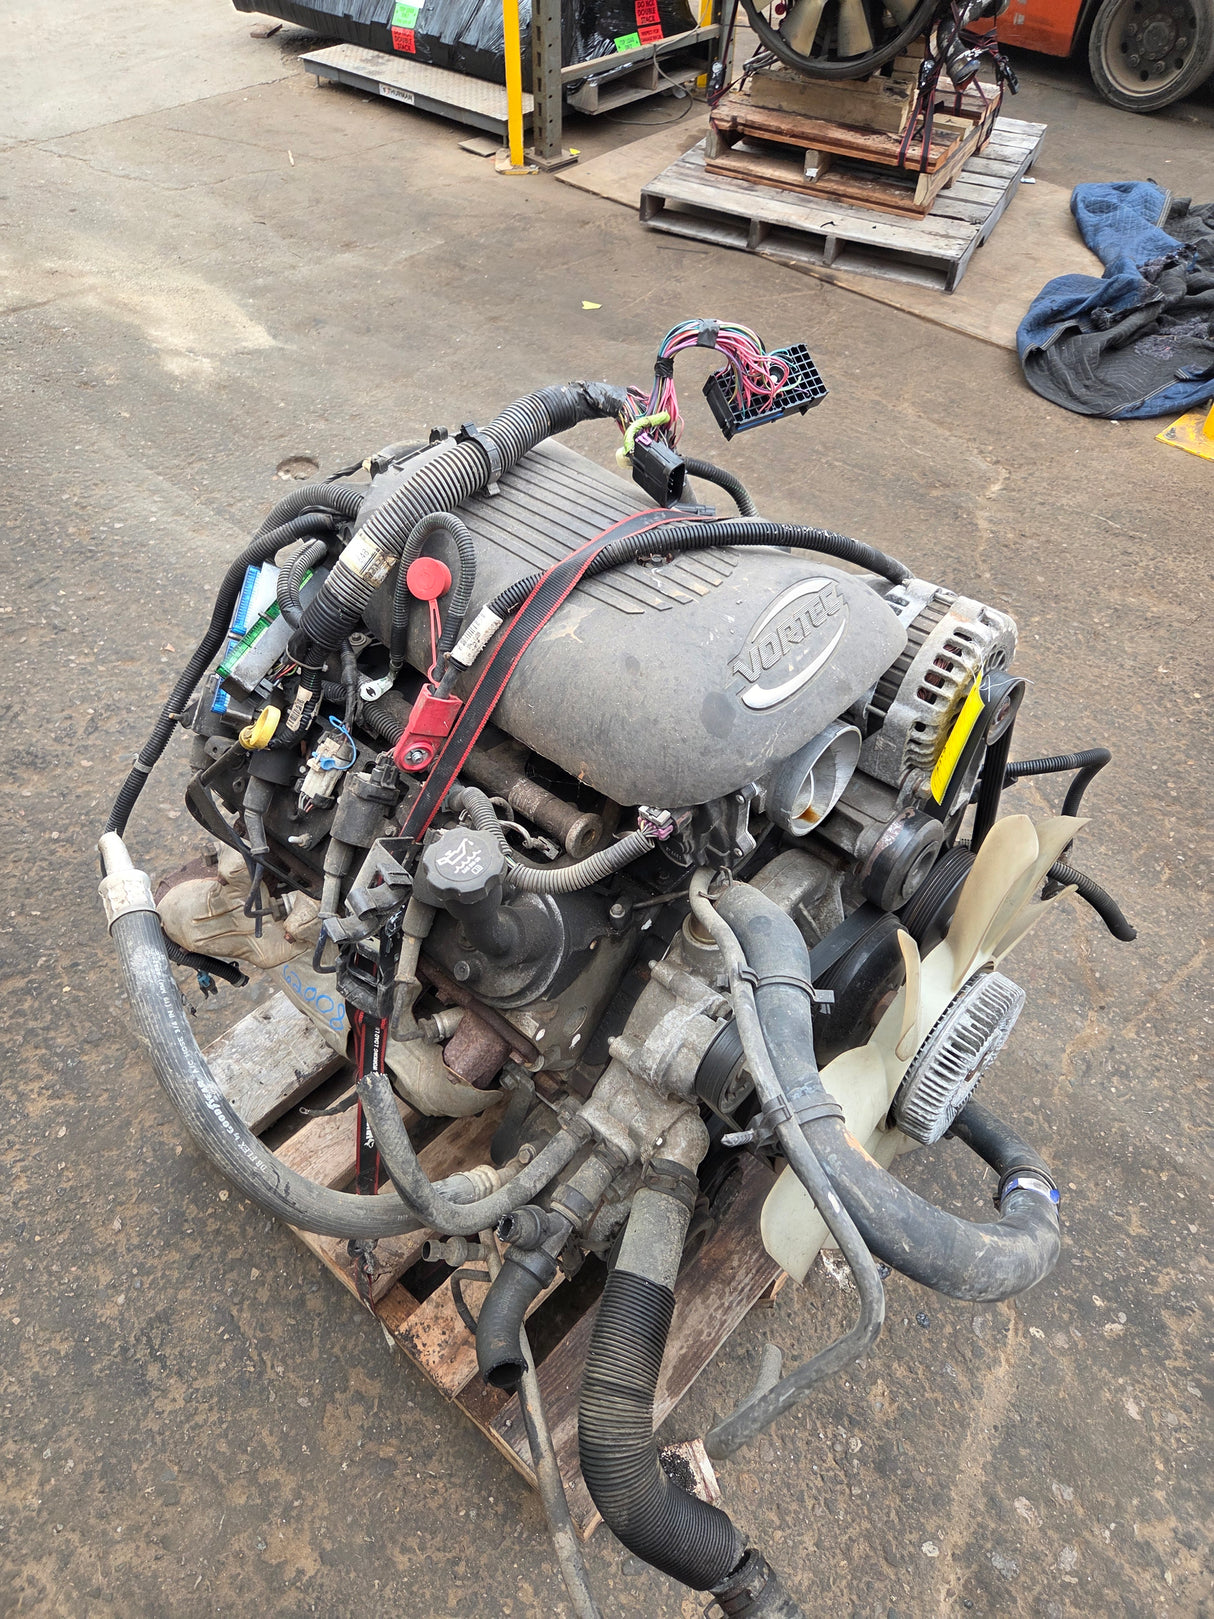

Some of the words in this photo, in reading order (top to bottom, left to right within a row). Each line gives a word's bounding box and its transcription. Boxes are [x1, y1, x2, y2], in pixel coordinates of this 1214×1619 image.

[732, 582, 843, 684] VORTEC
[171, 1020, 181, 1034] 3/4
[177, 1036, 191, 1057] HOSE
[372, 1047, 380, 1071] WORKING
[197, 1080, 234, 1134] GOODYEAR
